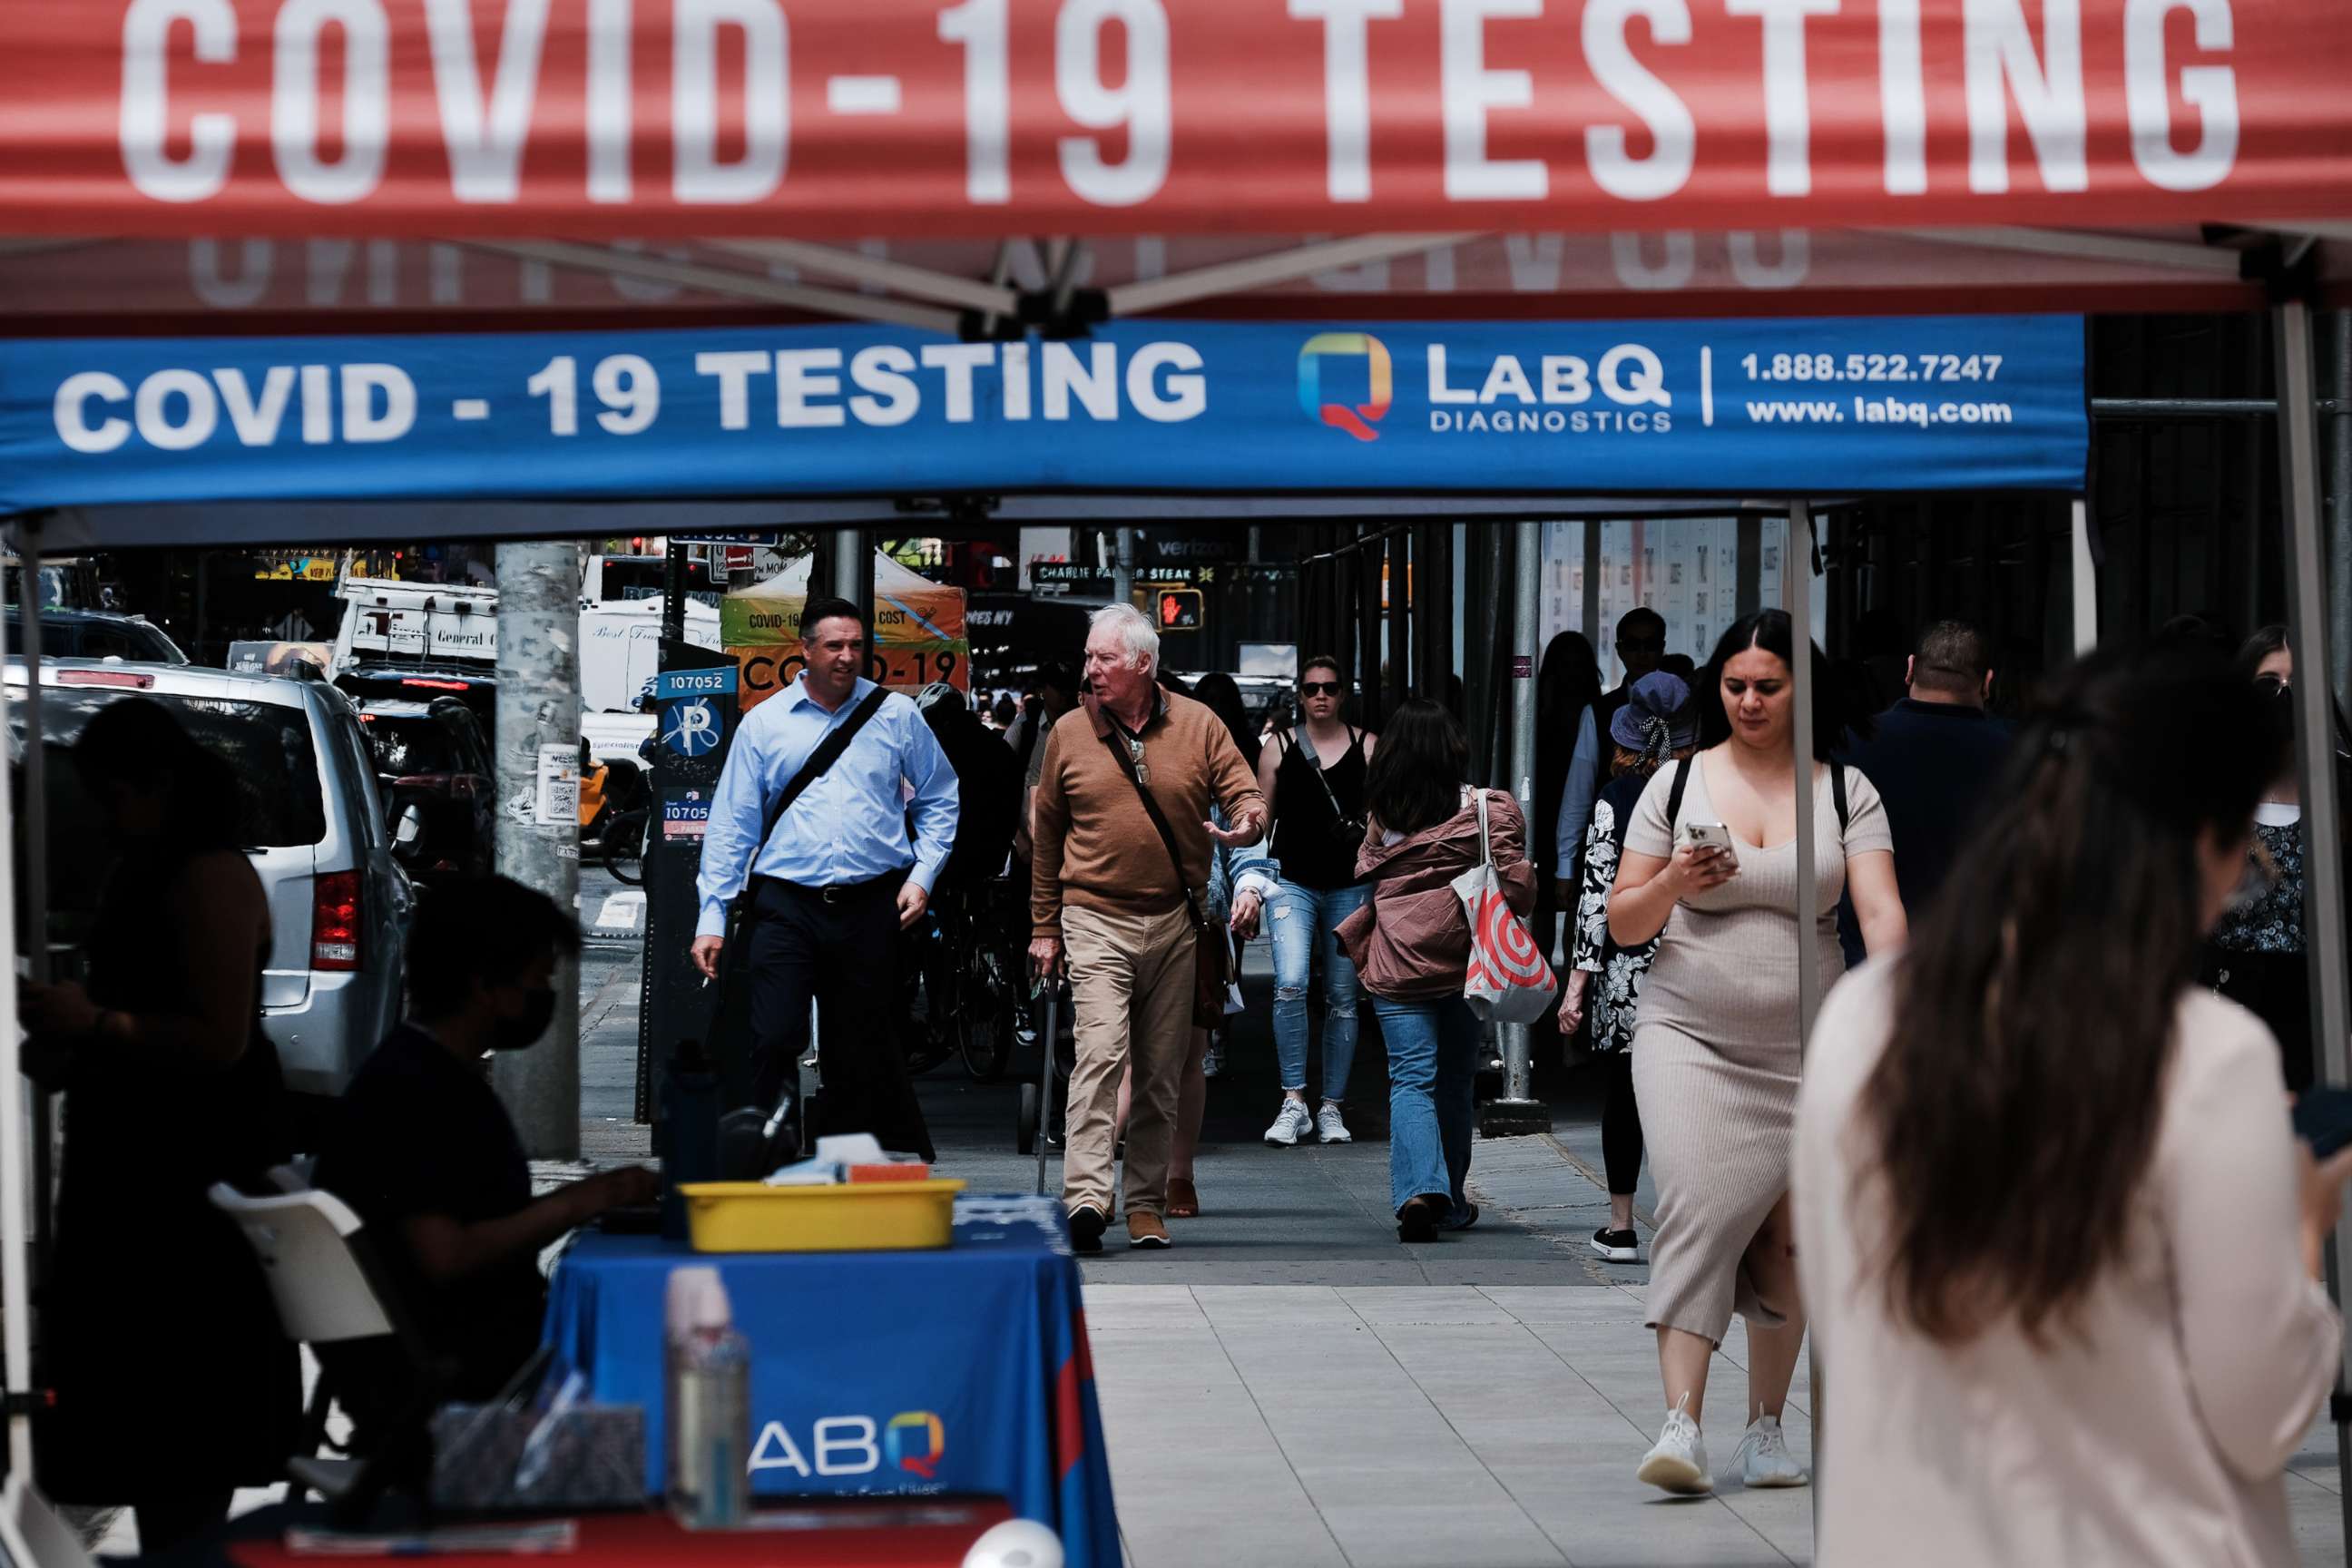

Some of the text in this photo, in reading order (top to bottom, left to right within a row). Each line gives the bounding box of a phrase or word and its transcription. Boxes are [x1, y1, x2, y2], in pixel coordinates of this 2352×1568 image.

[119, 0, 2241, 205] COVID-19 TESTING
[1427, 344, 1672, 407] LABQ
[1740, 354, 2003, 383] 1.888.522.7247
[53, 362, 416, 454] COVID
[527, 355, 661, 436] 19
[695, 341, 1207, 430] TESTING
[1430, 411, 1671, 434] DIAGNOSTICS
[1746, 397, 2013, 430] www. labq.com
[1157, 539, 1234, 556] verizon
[1150, 567, 1191, 580] STEAK
[750, 611, 906, 628] COVID-19 COST
[671, 676, 723, 689] 107052
[743, 651, 956, 691] CO-19
[665, 807, 708, 819] 10705
[746, 1410, 945, 1478] ABQ
